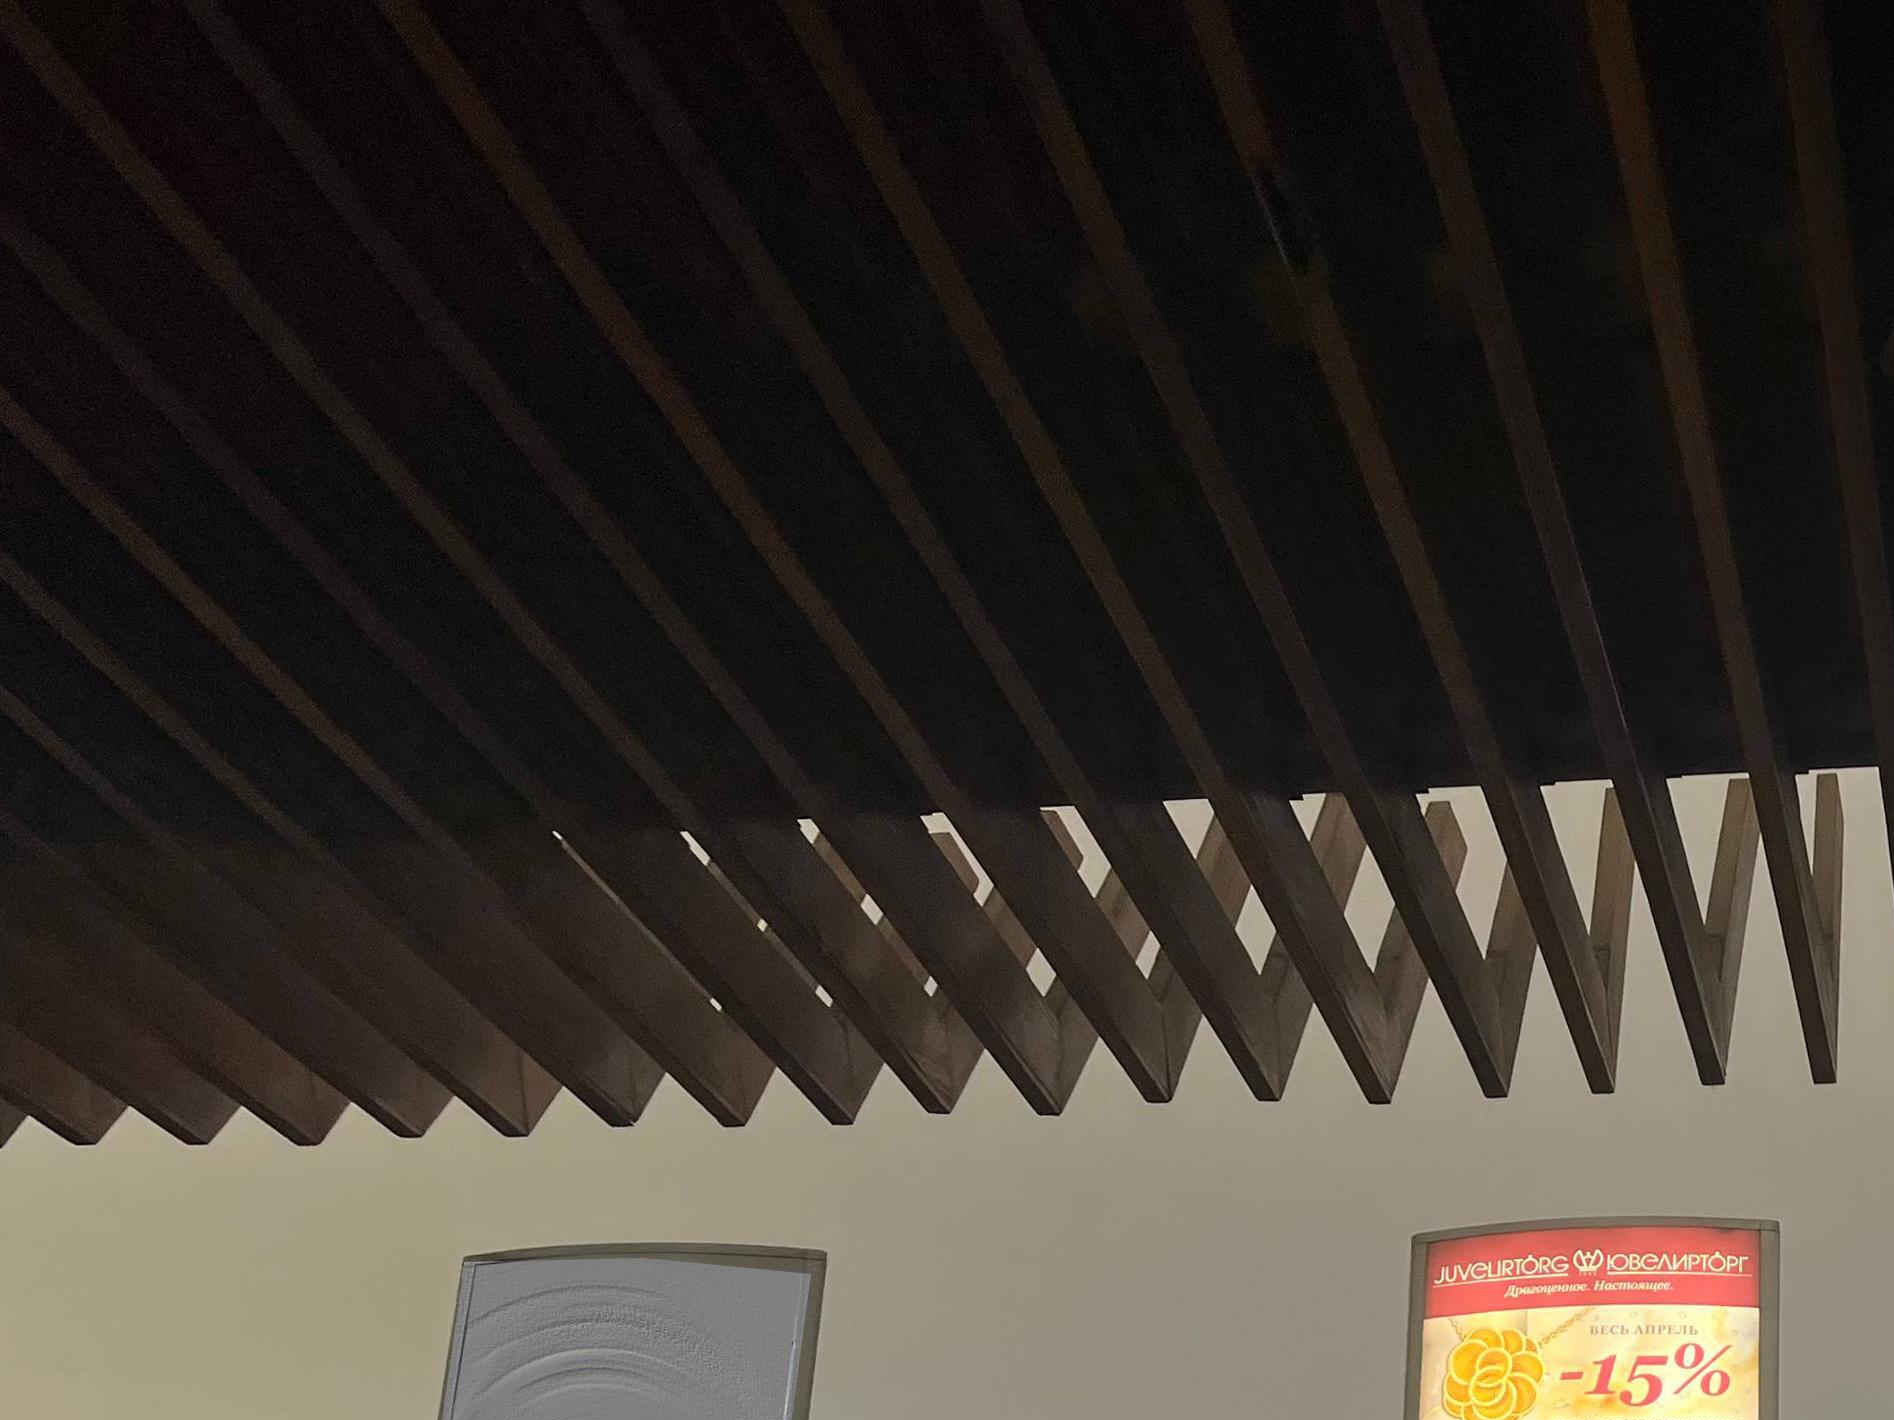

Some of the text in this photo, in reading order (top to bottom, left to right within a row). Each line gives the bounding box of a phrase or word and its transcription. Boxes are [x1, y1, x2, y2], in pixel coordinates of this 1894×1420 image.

[1607, 1251, 1749, 1274] ЮВЕЛИРТОРГ
[1590, 1325, 1699, 1336] ВЕСЬ АПРЕЛЬ
[1560, 1343, 1732, 1407] -15%
